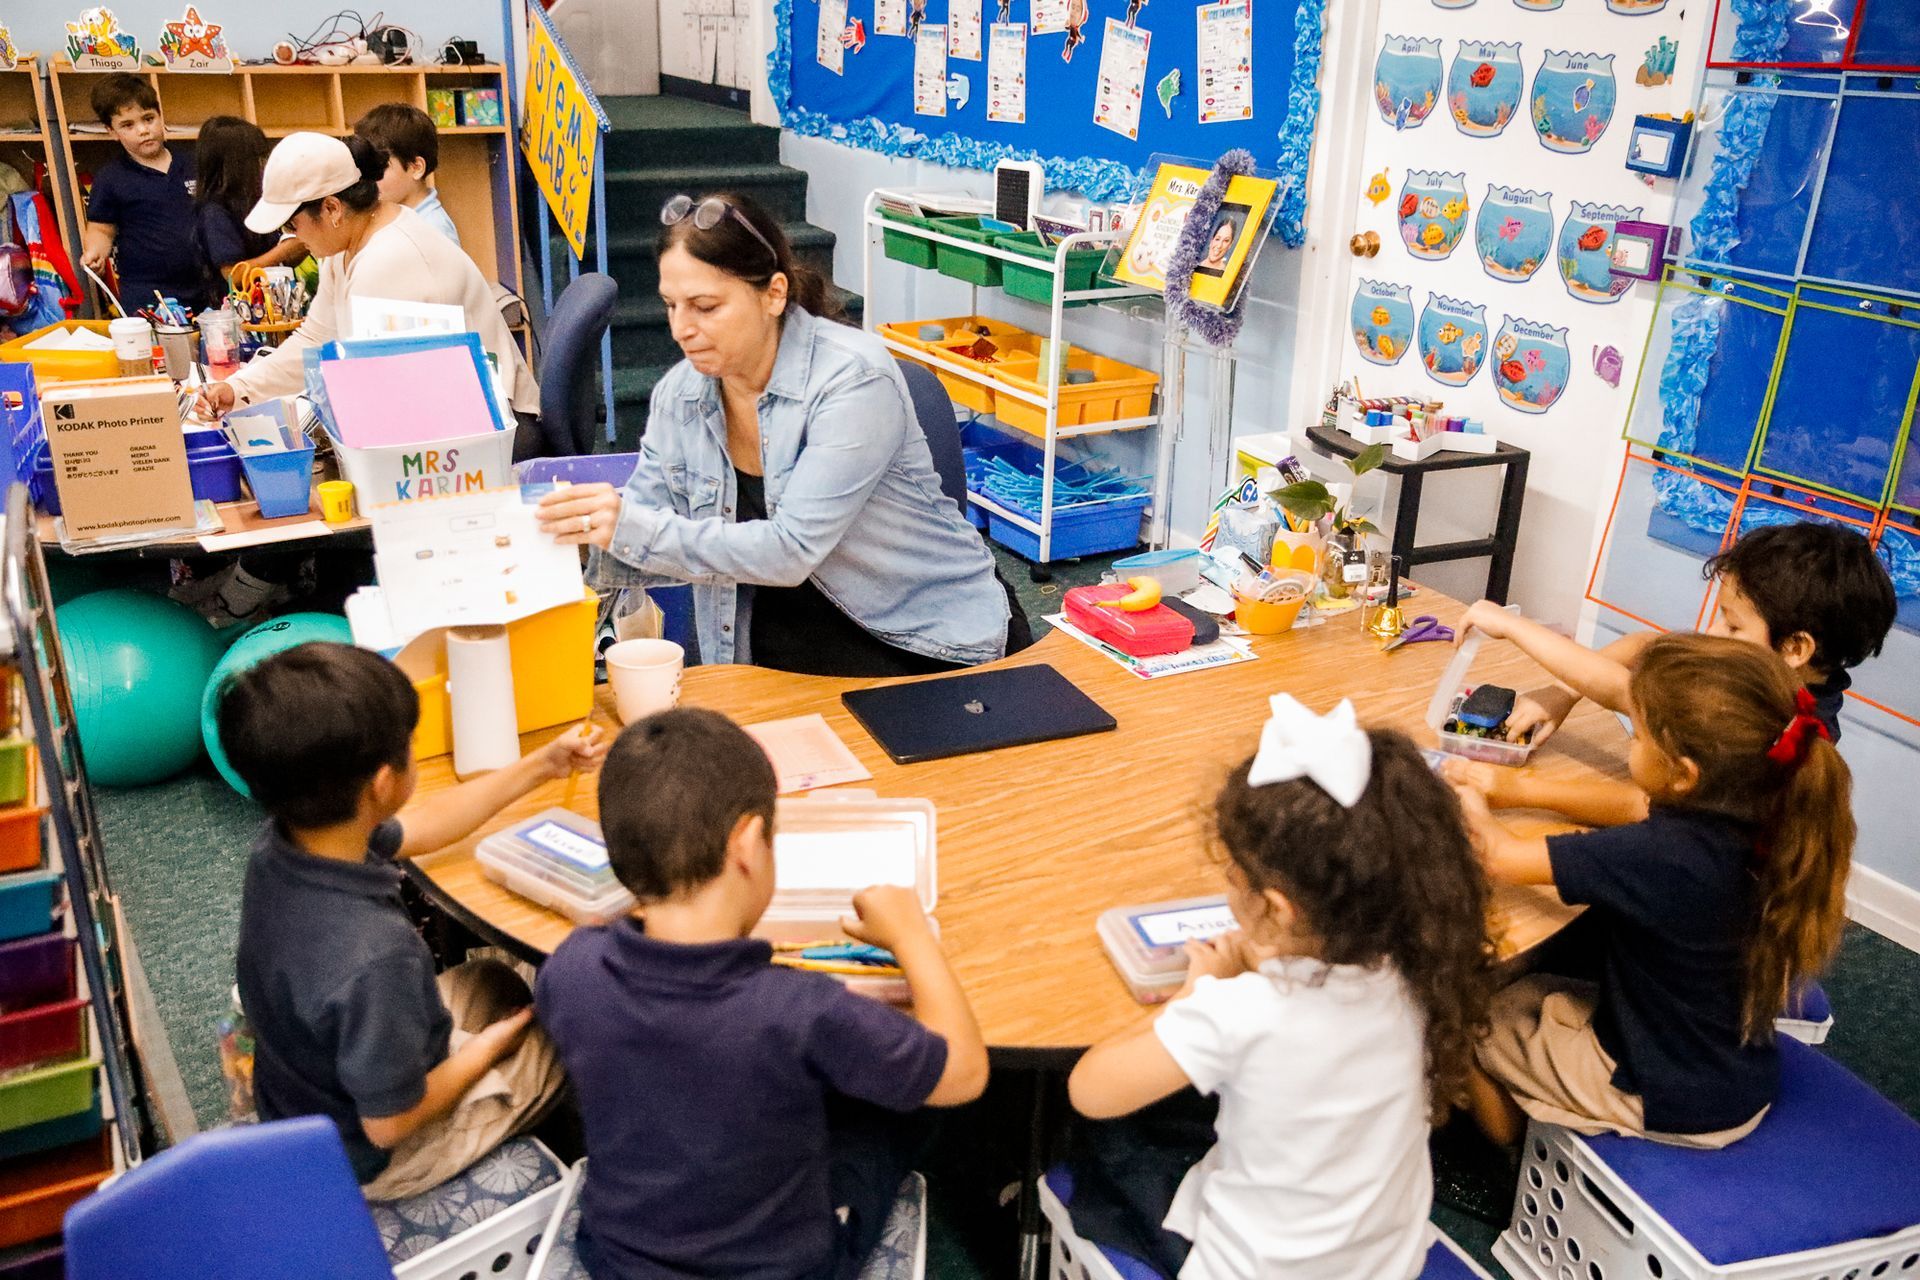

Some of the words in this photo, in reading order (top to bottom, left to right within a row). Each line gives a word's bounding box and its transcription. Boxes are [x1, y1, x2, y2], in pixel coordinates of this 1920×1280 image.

[1401, 43, 1420, 54] April
[1478, 47, 1497, 60] May
[89, 58, 123, 69] Thiago
[189, 59, 209, 68] Zair
[1565, 61, 1589, 71] June
[1168, 180, 1184, 193] Mrs.
[1185, 182, 1199, 196] Kar
[1426, 177, 1443, 188] July
[1503, 191, 1533, 204] August
[1371, 286, 1396, 297] October
[1437, 300, 1474, 318] November
[1513, 323, 1554, 341] December
[57, 421, 95, 432] KODAK
[97, 419, 128, 429] Photo
[130, 416, 164, 426] Printer
[402, 449, 460, 477] MRS
[396, 469, 484, 500] KARIM
[77, 515, 182, 532] www.kodakphotoprinter.com
